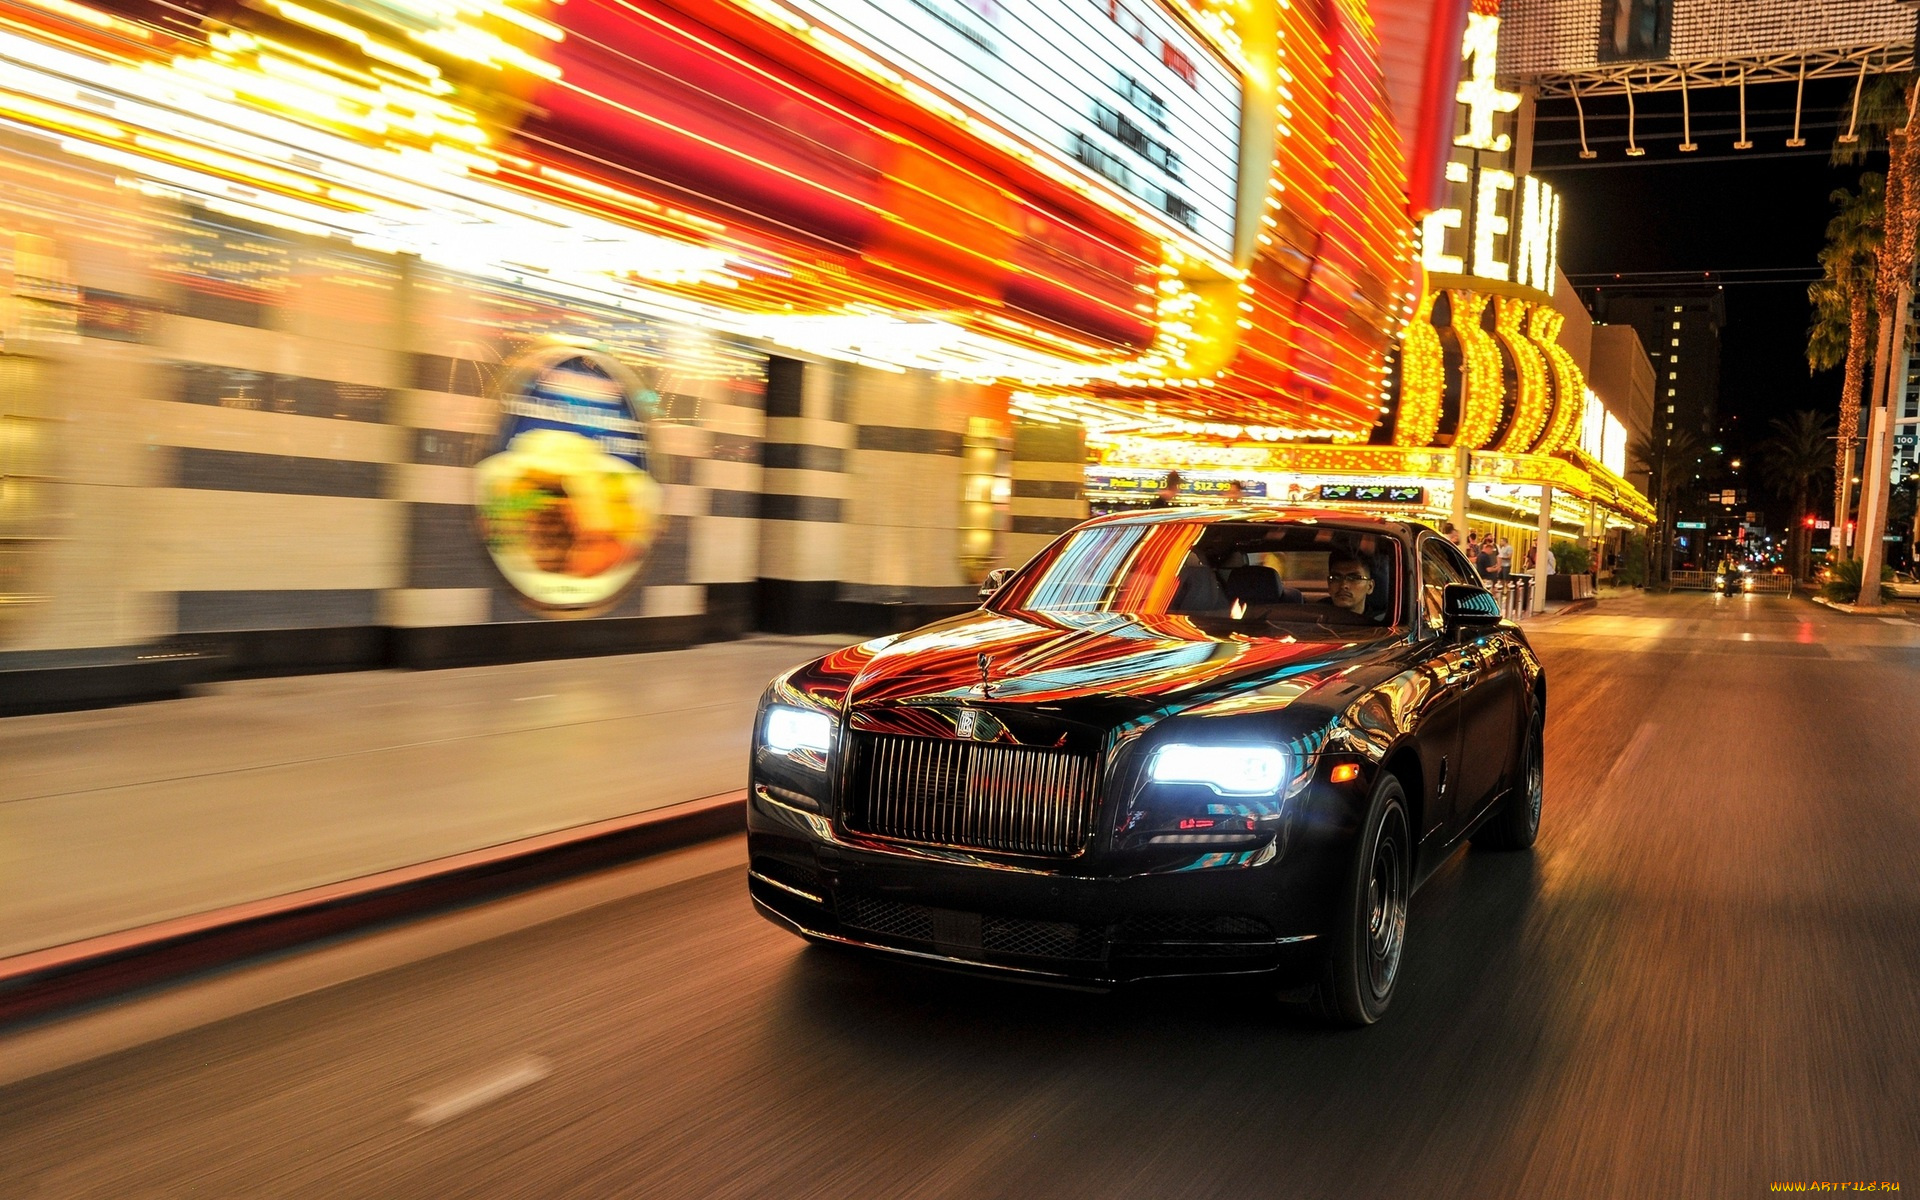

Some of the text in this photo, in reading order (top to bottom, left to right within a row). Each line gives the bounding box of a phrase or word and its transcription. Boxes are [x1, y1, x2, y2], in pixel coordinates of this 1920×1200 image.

[1421, 161, 1560, 297] EEN
[1897, 436, 1914, 444] 100
[1110, 478, 1138, 488] Prime
[1159, 480, 1191, 490] Der
[1193, 481, 1231, 491] $12.99
